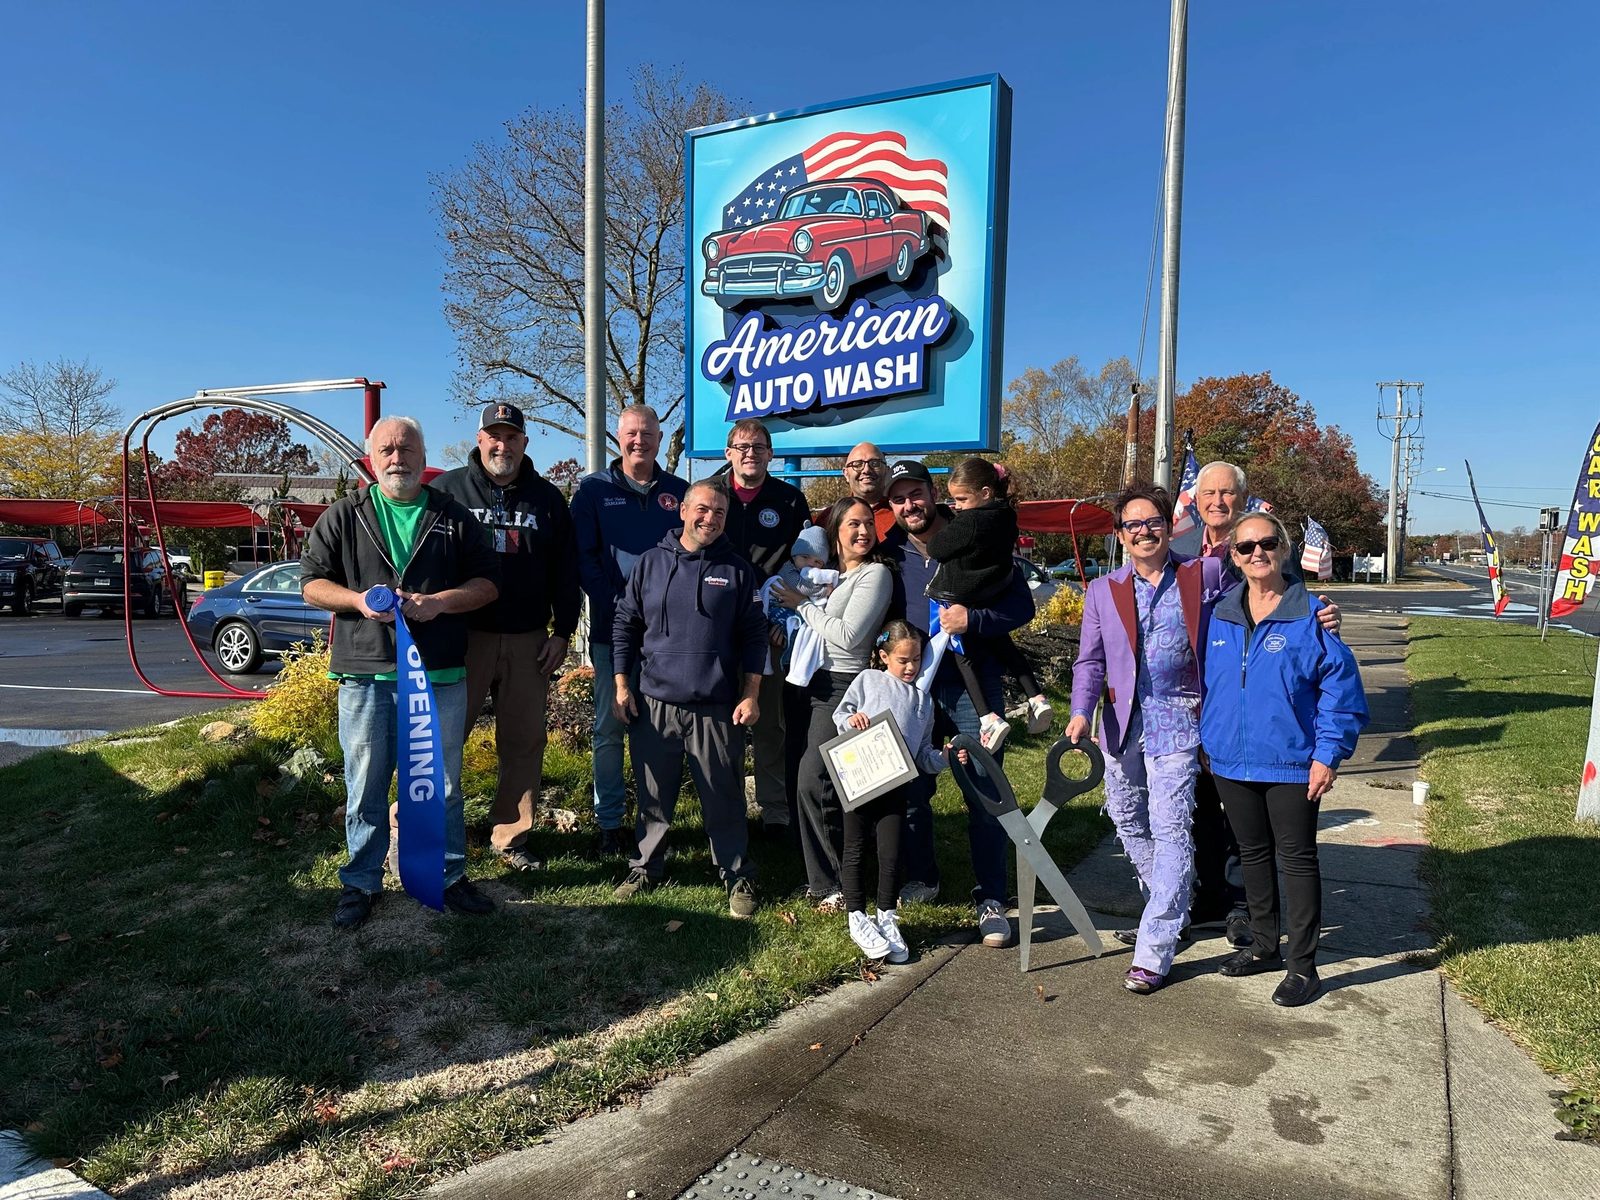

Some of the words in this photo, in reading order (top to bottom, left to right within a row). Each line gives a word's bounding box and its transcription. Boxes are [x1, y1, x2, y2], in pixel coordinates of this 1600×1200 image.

[707, 302, 944, 377] American
[733, 373, 814, 415] AUTO
[823, 352, 918, 398] WASH
[468, 508, 539, 530] TALIA
[1562, 511, 1600, 602] WASH
[407, 644, 435, 803] OPENING
